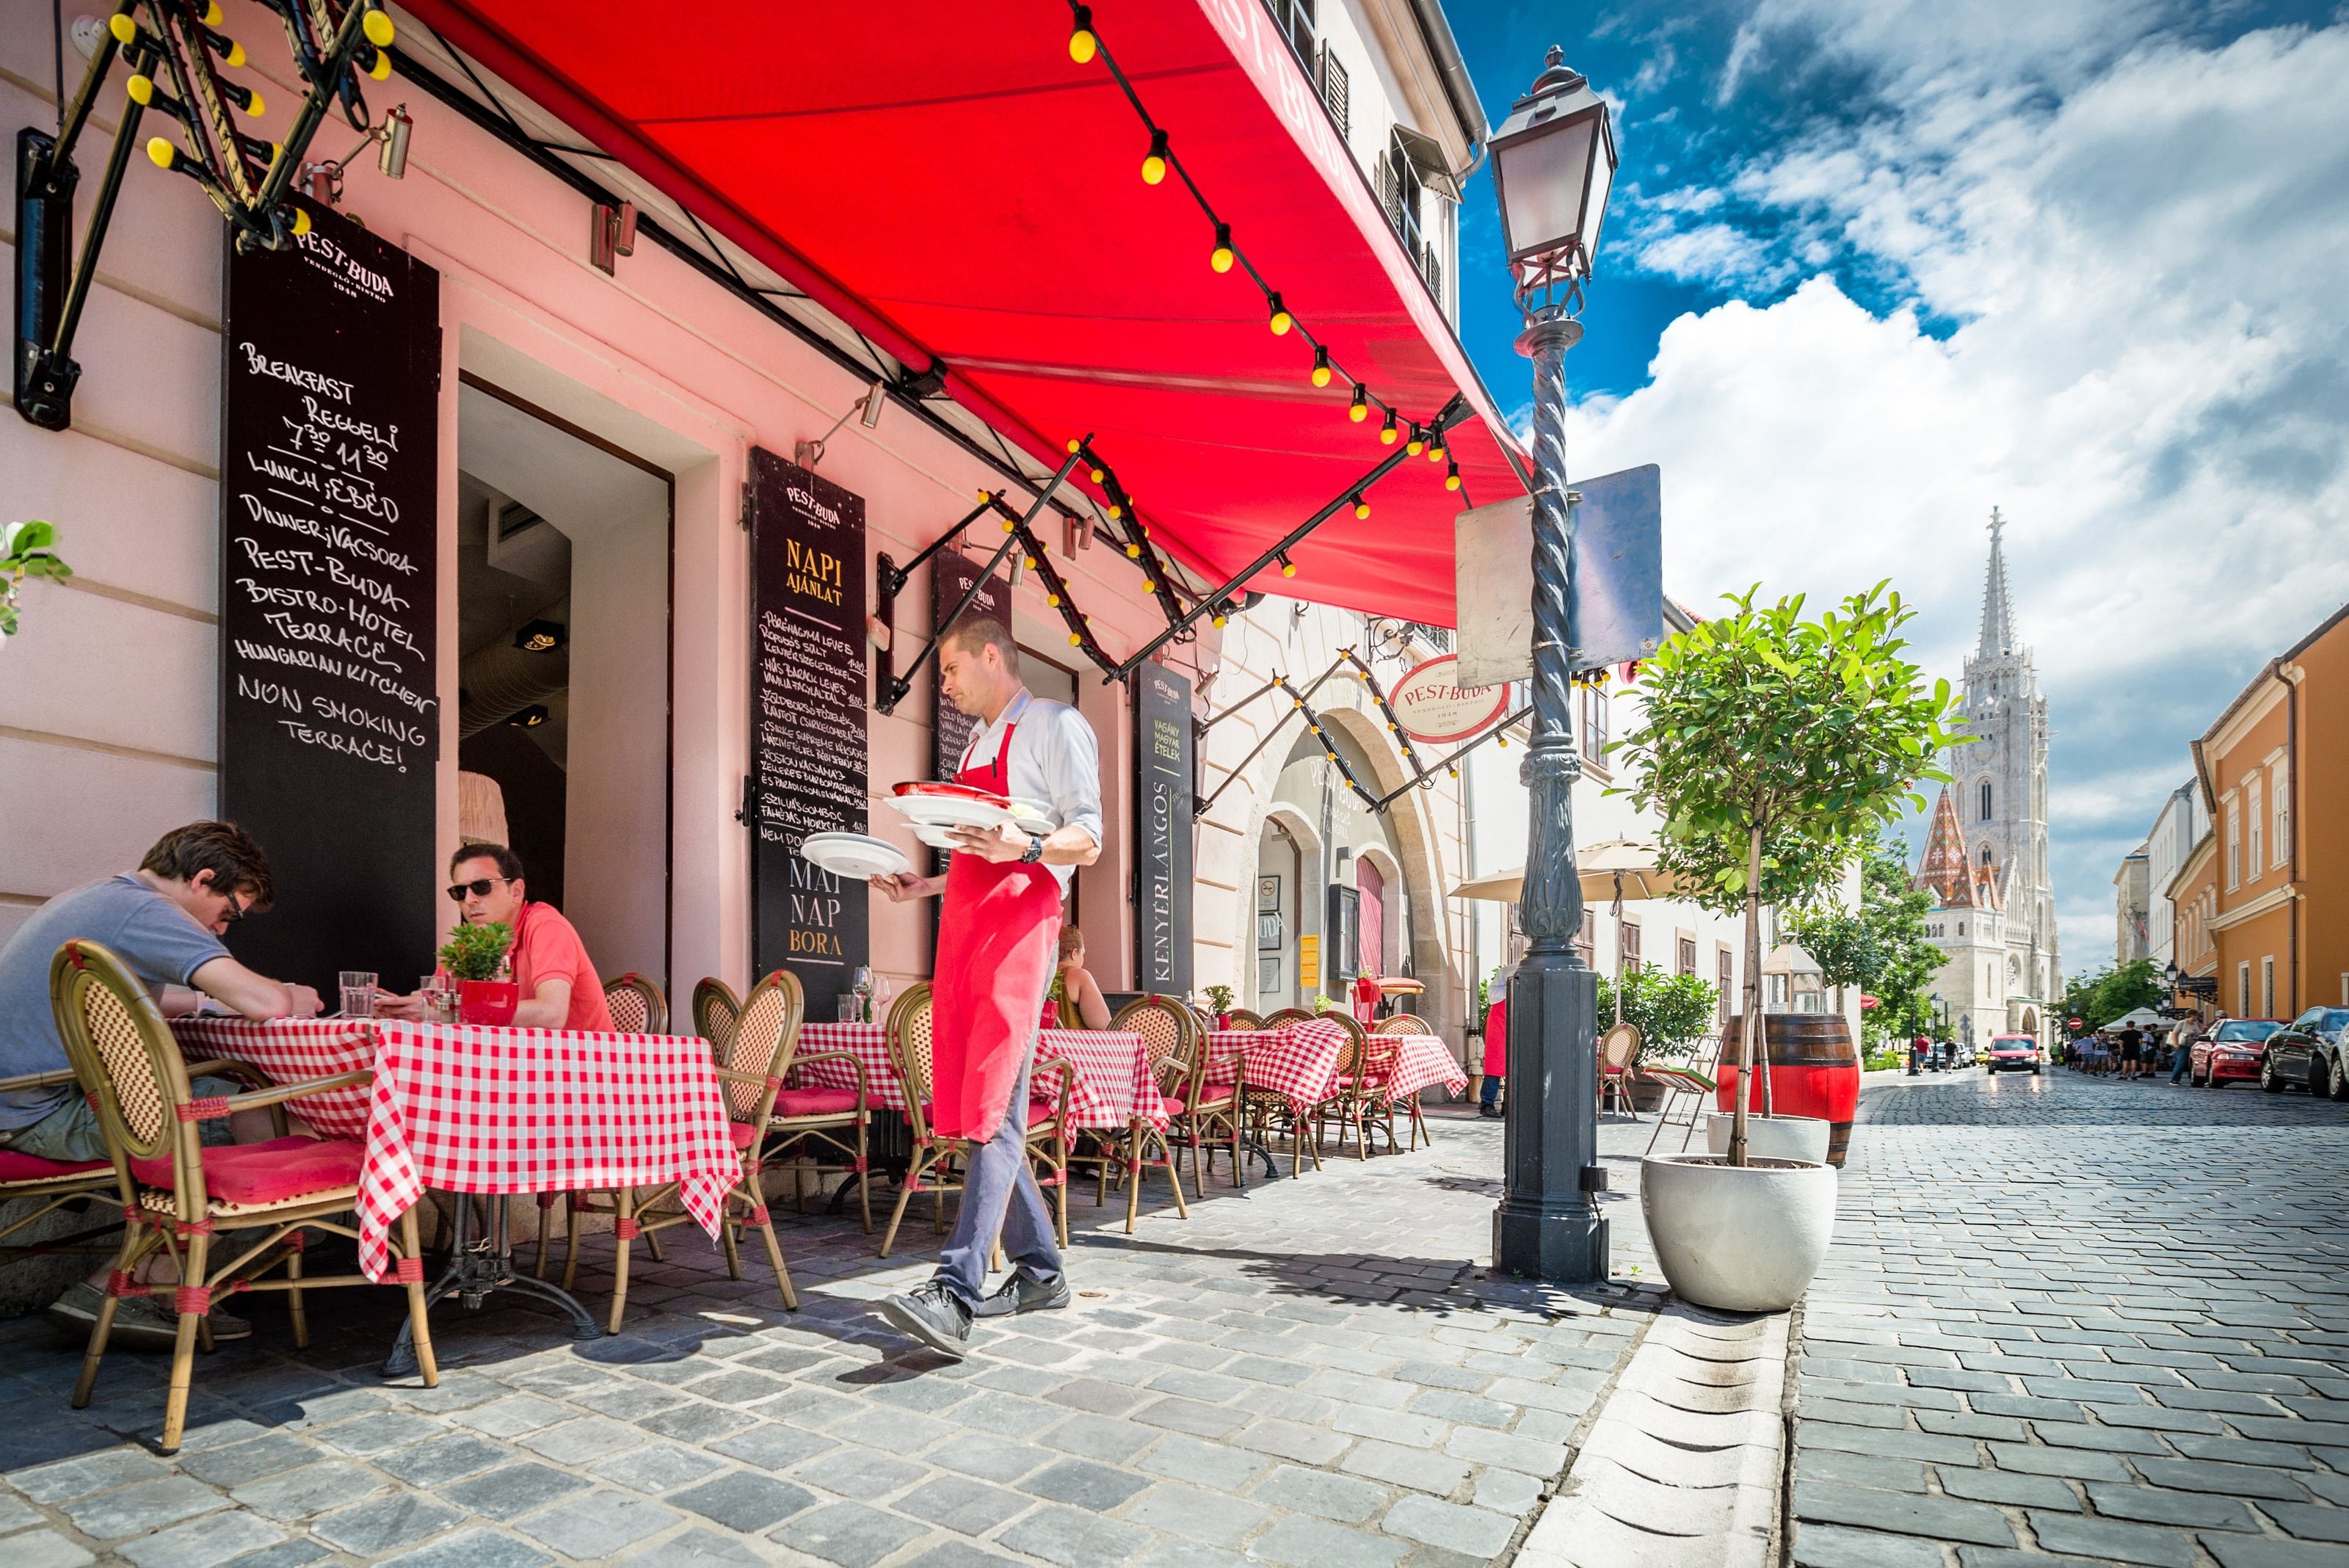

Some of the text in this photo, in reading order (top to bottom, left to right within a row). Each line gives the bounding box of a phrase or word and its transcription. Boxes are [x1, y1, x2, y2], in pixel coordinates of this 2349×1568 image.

[239, 341, 354, 405] BREAKFAST
[302, 396, 399, 452] REGGELI
[234, 537, 410, 611] PEST-BUDA
[786, 538, 842, 587] NAPI
[786, 572, 842, 606] AJÁNLAT
[235, 578, 425, 662] BISTRO-HOTEL
[264, 611, 402, 673] TERRACE
[822, 635, 854, 656] LEVES
[234, 639, 437, 714] HUNGARIAN KITCHEN
[819, 677, 847, 696] LEVES
[239, 674, 426, 747] NON SMOKING
[277, 719, 407, 773] TERRACE!
[1154, 730, 1180, 750] MAGYAR
[1155, 740, 1180, 763] ÉTELEK
[760, 826, 784, 843] NEM
[790, 859, 841, 894] MAI
[1152, 782, 1169, 982] KENYÉRLÁNGOS
[791, 894, 841, 927] NAP
[790, 929, 843, 955] BORA
